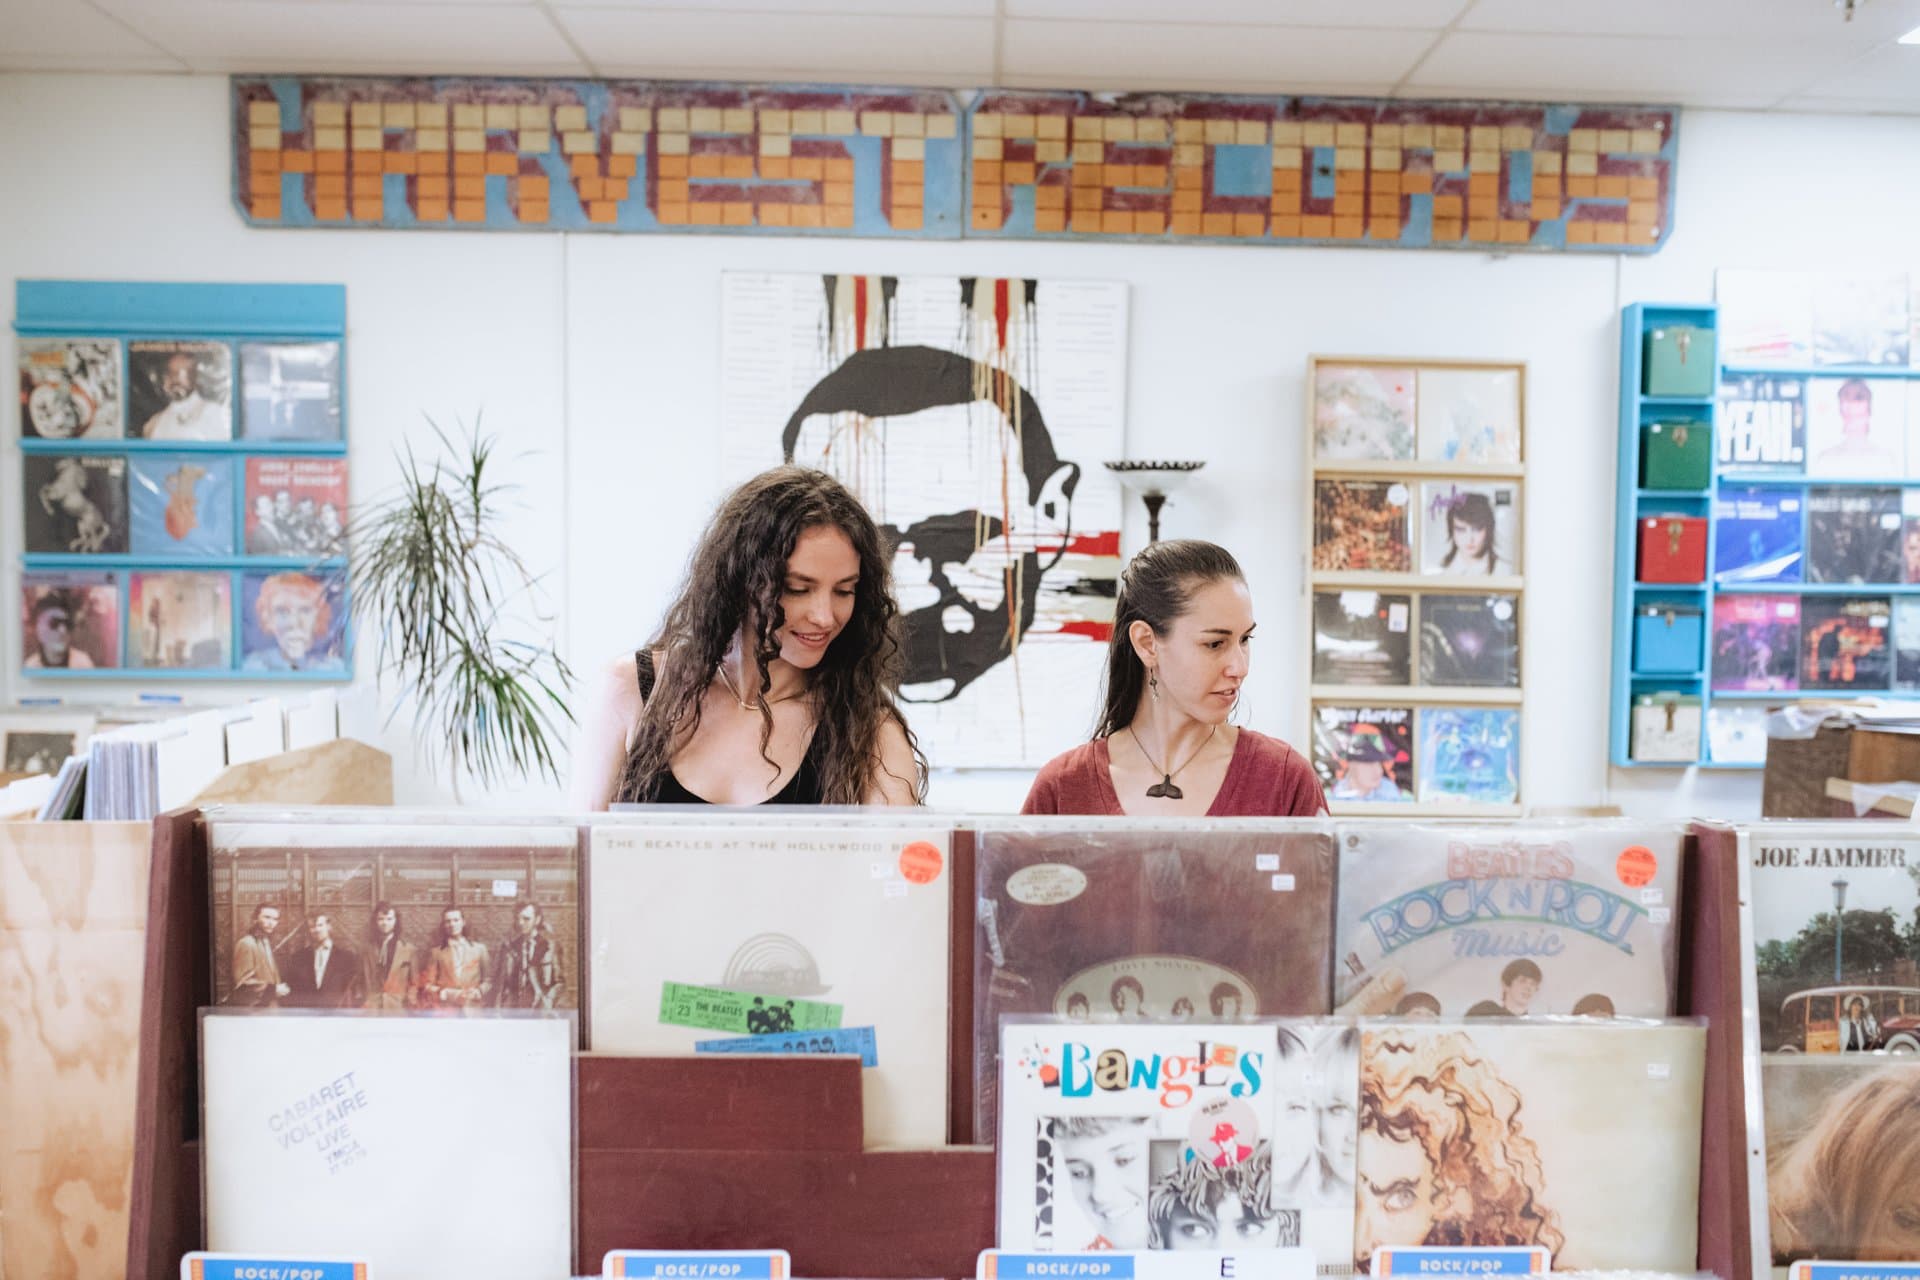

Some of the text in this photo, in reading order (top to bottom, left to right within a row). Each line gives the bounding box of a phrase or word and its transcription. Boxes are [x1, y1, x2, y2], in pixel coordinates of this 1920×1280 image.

[249, 100, 1662, 246] HARVEST RECORDS
[606, 839, 636, 849] THE
[645, 840, 713, 850] BEATLES
[722, 841, 740, 850] AT
[749, 841, 777, 850] THE
[787, 842, 883, 852] HOLLYWOOD
[1447, 841, 1575, 880] BEATLES
[1754, 847, 1906, 868] JOE JAMMER
[1368, 876, 1502, 958] ROCK
[1451, 928, 1566, 957] Music
[677, 1004, 691, 1017] 23
[695, 1001, 744, 1017] THE BEATLES
[268, 1071, 356, 1133] CABARET
[277, 1089, 369, 1151] VOLTAIRE
[317, 1122, 352, 1153] LIVE
[234, 1267, 324, 1280] ROCK/POP
[654, 1263, 742, 1277] ROCK/POP
[1025, 1261, 1112, 1276] ROCK/POP
[1419, 1258, 1504, 1273] ROCK/POP
